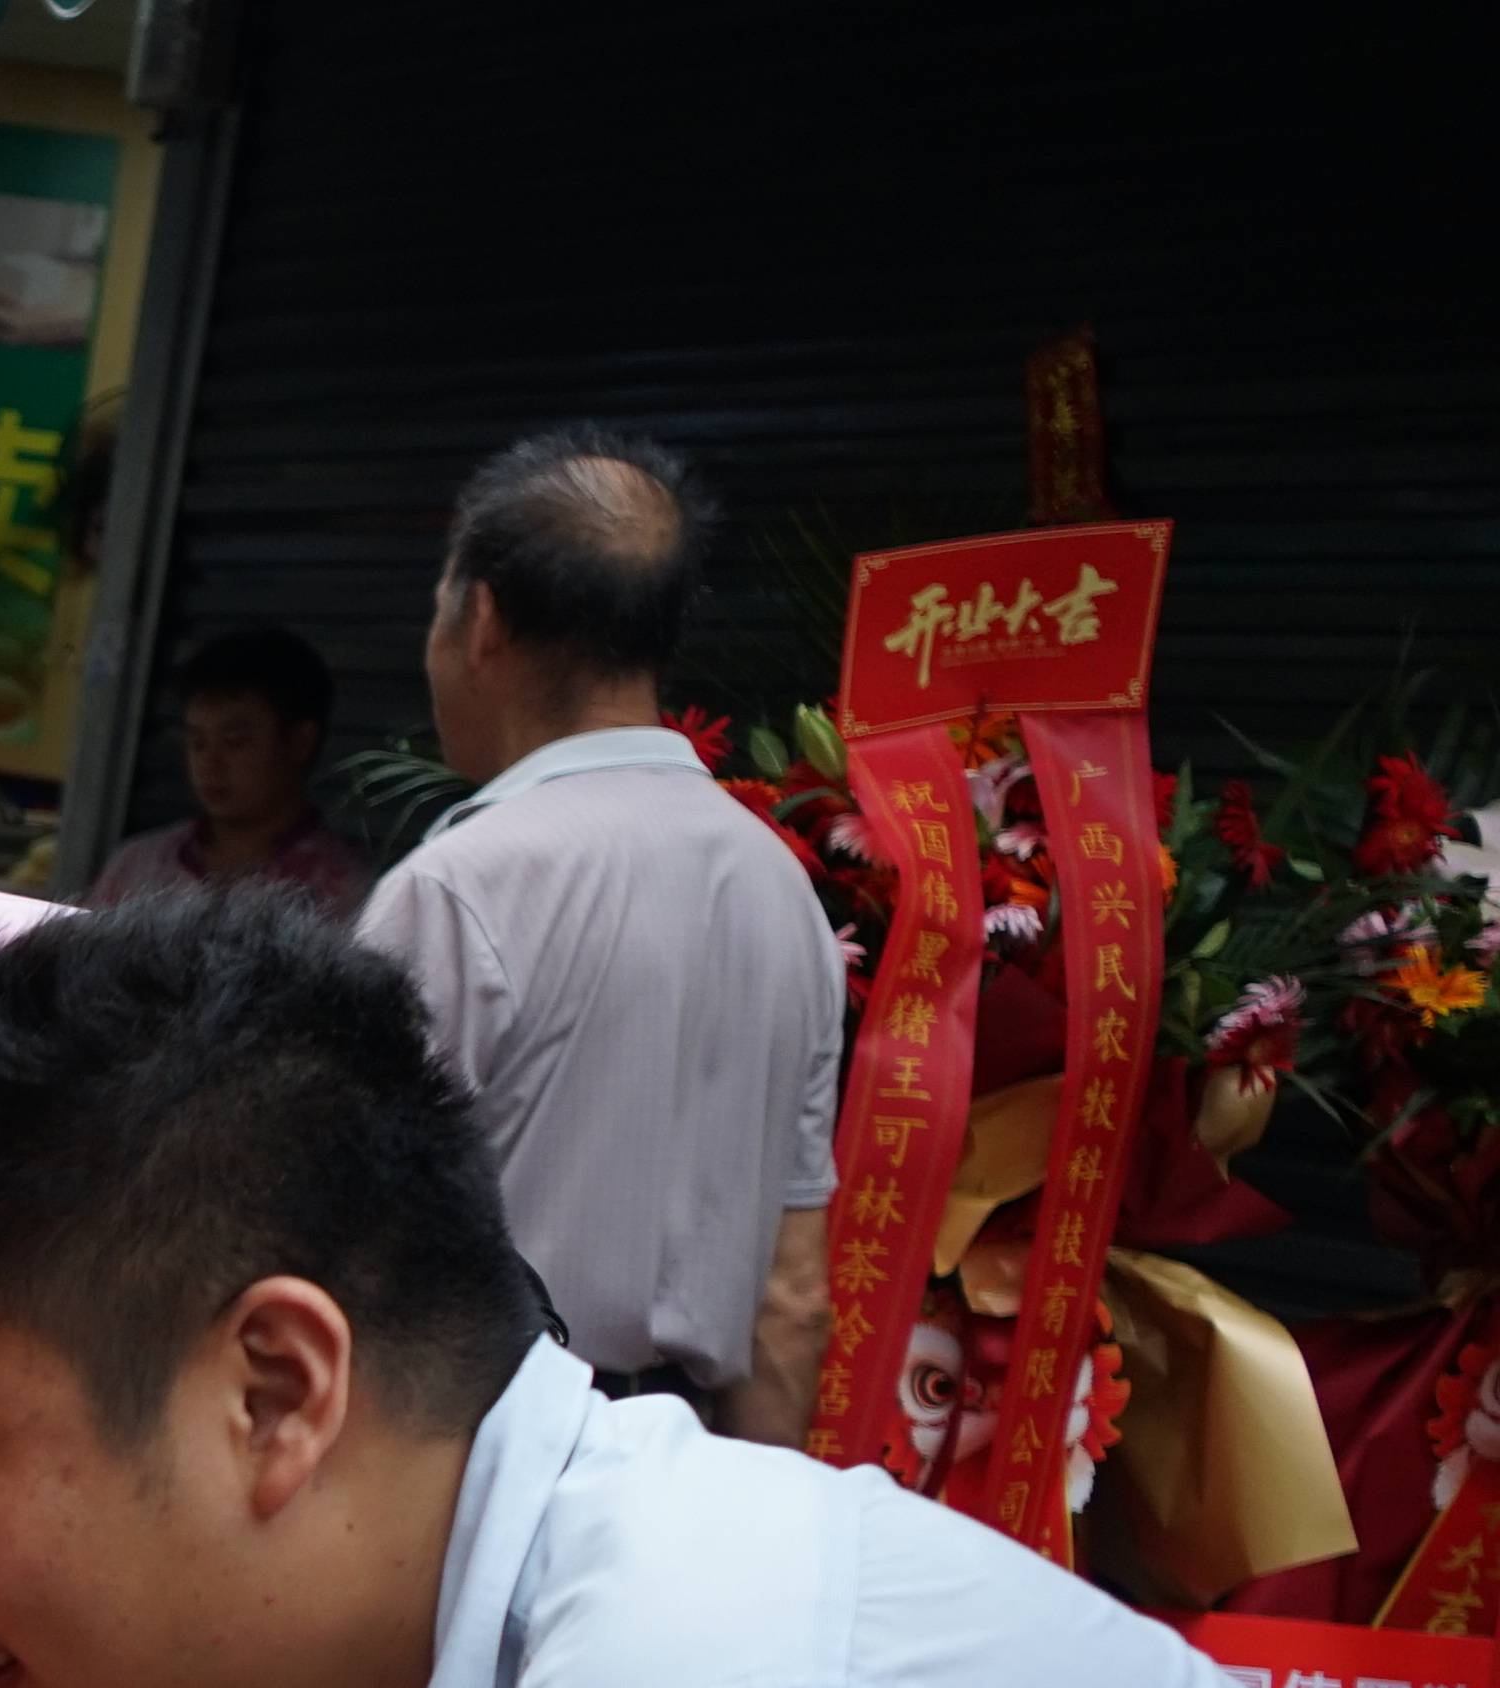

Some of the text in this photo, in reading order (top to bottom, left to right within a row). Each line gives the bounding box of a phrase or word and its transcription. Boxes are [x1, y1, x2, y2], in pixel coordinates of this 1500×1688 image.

[884, 562, 1120, 690] 开业大吉
[999, 759, 1137, 1534] 广西兴民农牧科技有限公司
